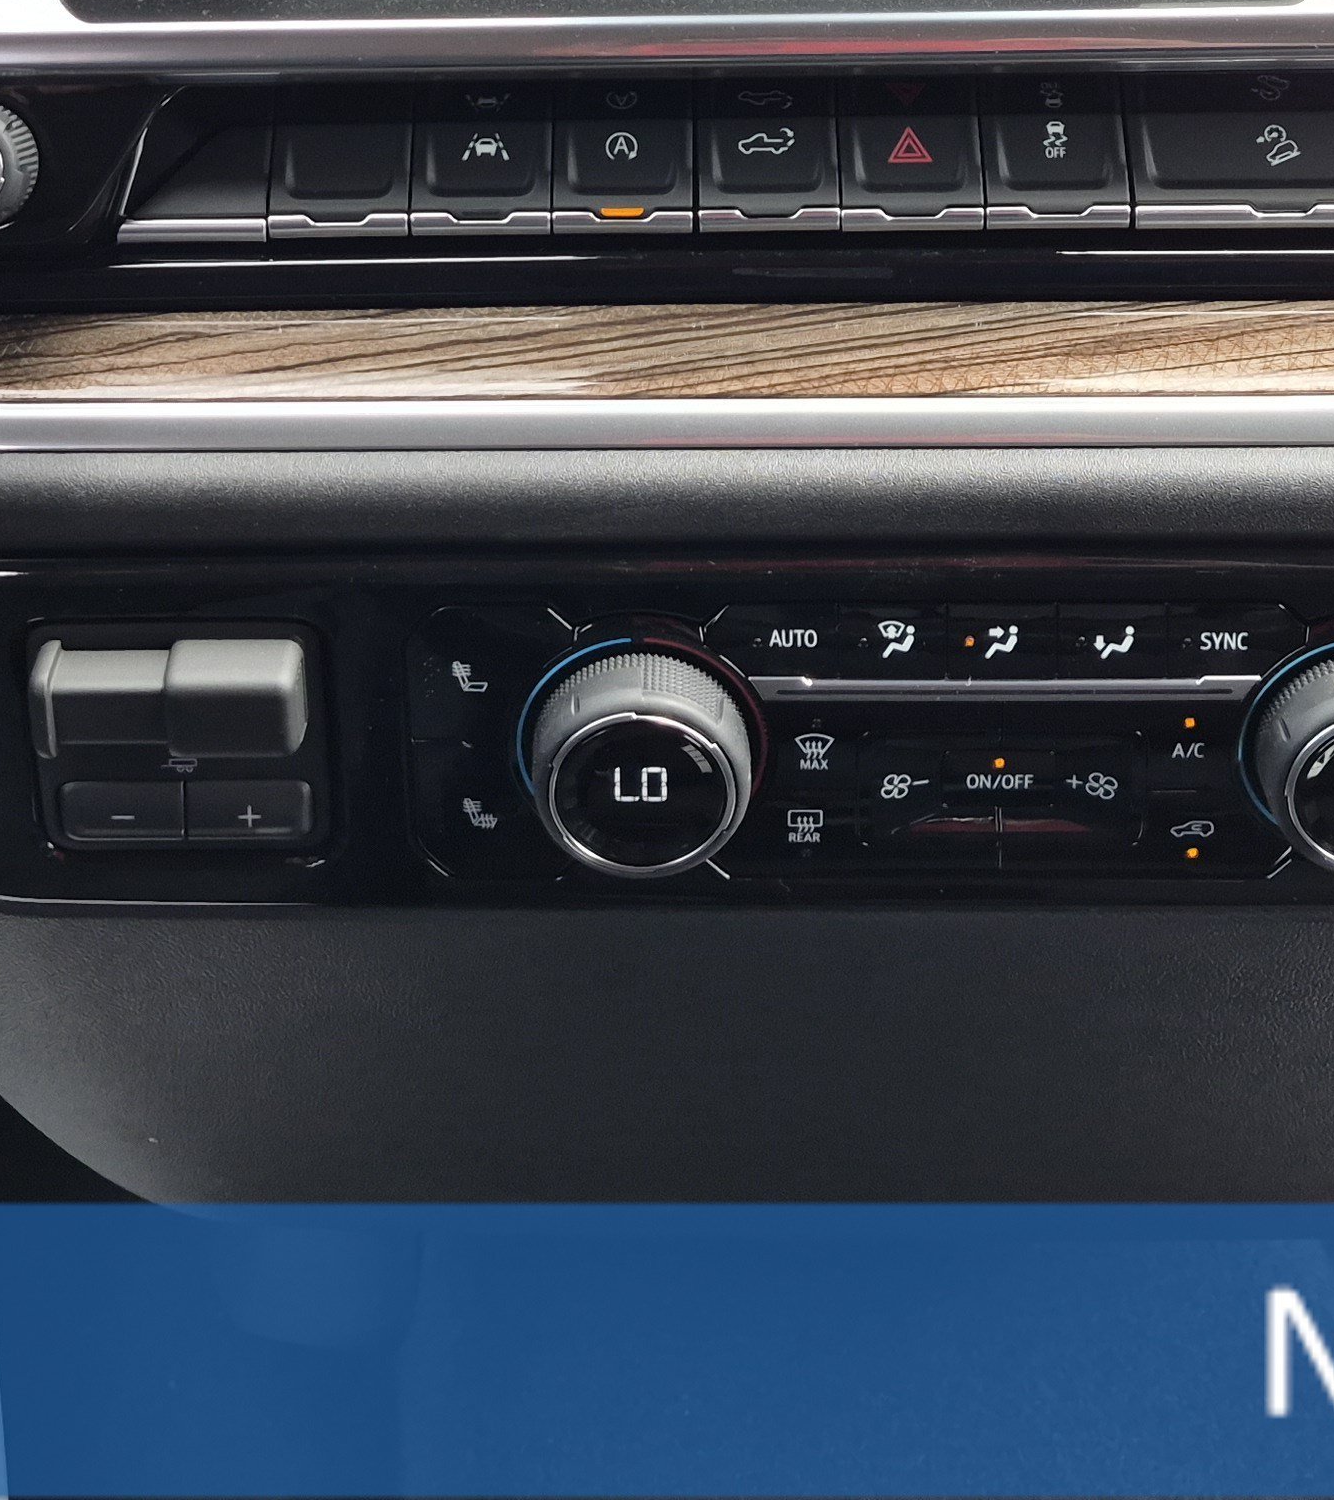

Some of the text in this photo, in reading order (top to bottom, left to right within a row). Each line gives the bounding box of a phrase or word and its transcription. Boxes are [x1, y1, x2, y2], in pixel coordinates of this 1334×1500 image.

[1044, 146, 1067, 159] OFF
[769, 630, 818, 648] AUTO
[1199, 632, 1249, 651] SYNC
[1171, 742, 1205, 760] A/C
[799, 757, 829, 770] MAX
[966, 774, 1034, 790] ON/OFF
[788, 833, 821, 843] REAR
